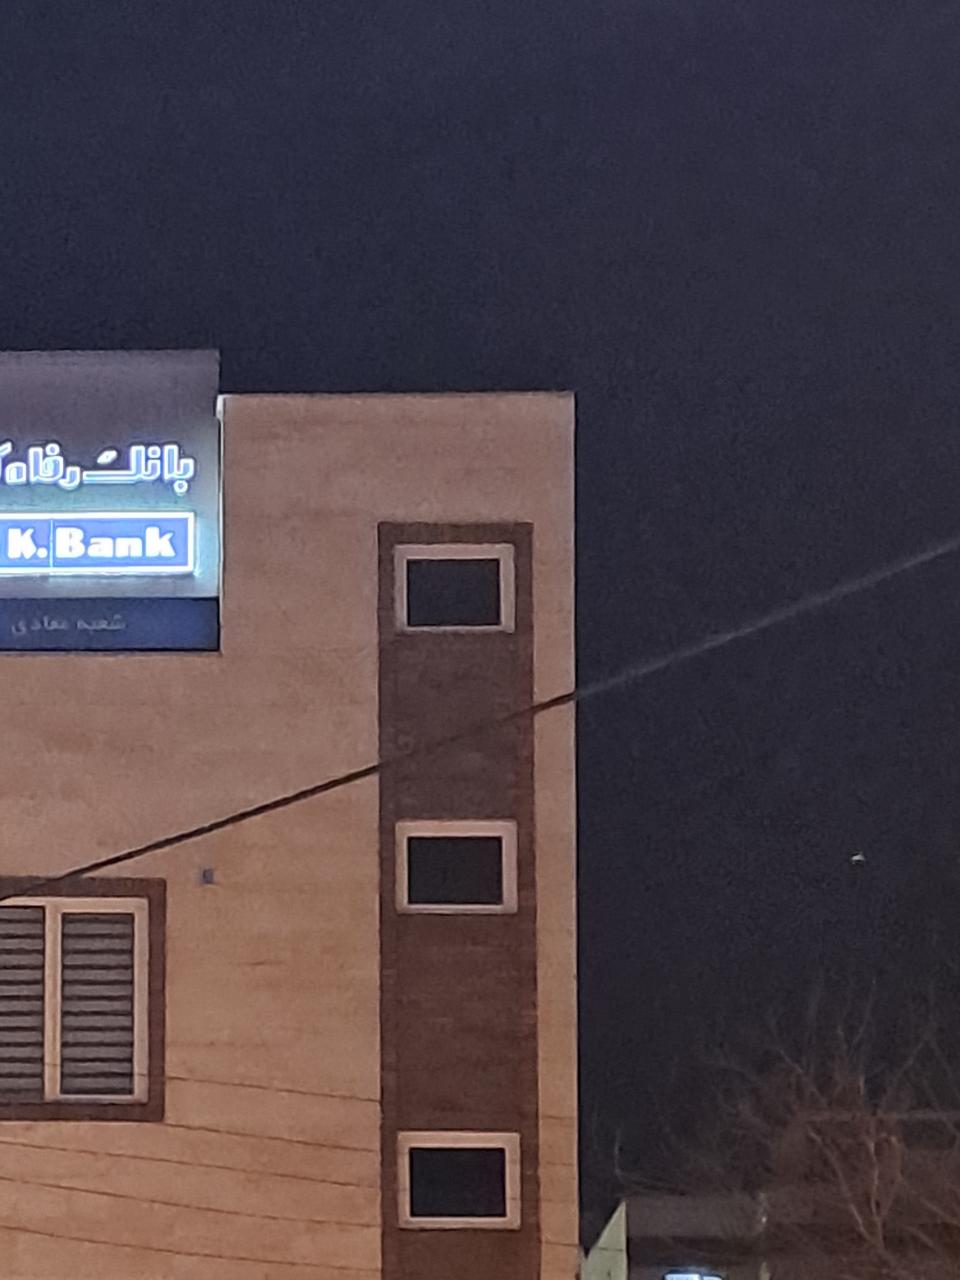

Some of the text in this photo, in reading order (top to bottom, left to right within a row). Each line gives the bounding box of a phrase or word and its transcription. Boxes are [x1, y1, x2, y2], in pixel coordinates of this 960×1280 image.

[5, 442, 82, 492] رفاه
[82, 445, 195, 496] بانک
[7, 527, 49, 561] K.
[55, 526, 177, 560] Bank
[76, 613, 126, 635] شعبه
